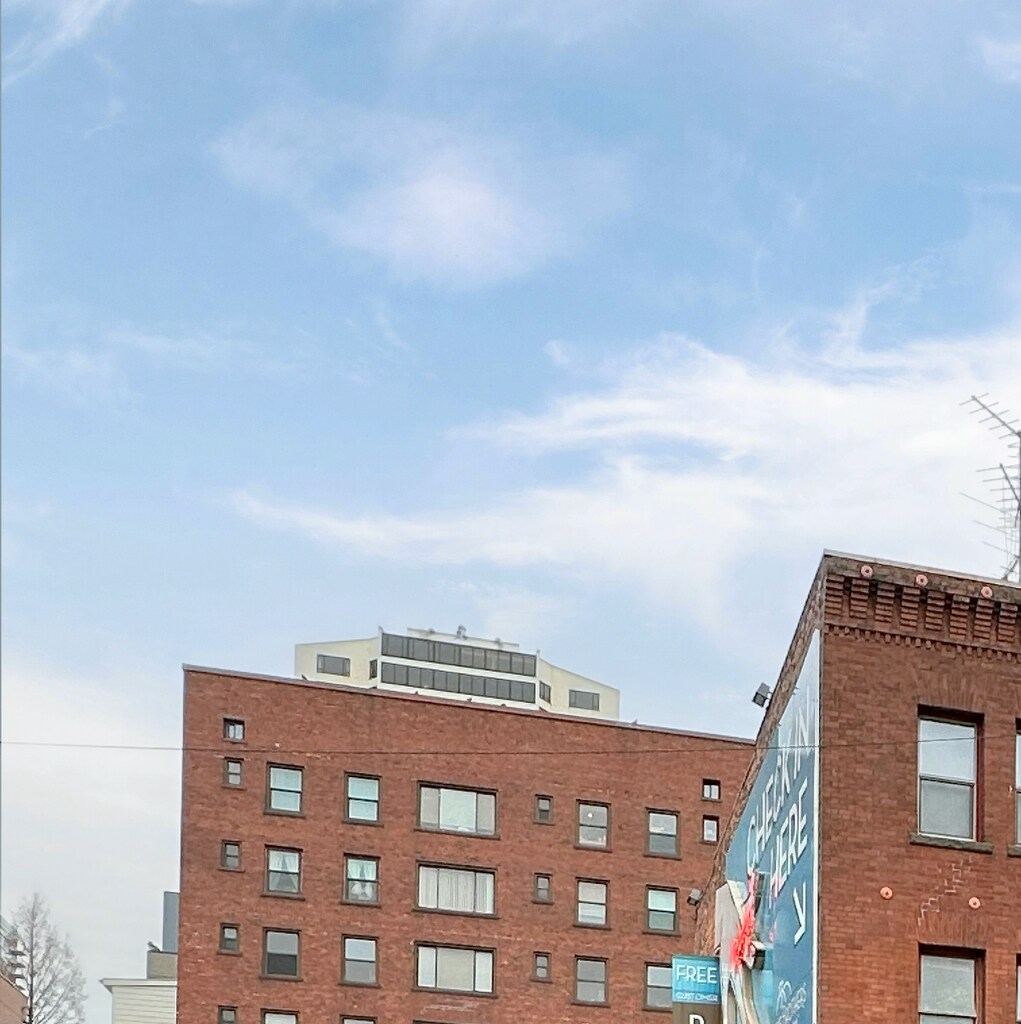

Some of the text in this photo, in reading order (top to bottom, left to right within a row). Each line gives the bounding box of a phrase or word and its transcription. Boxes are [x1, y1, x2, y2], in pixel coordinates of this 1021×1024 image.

[746, 684, 811, 876] CHECK IN
[769, 776, 808, 908] HERE
[676, 965, 718, 984] FREE
